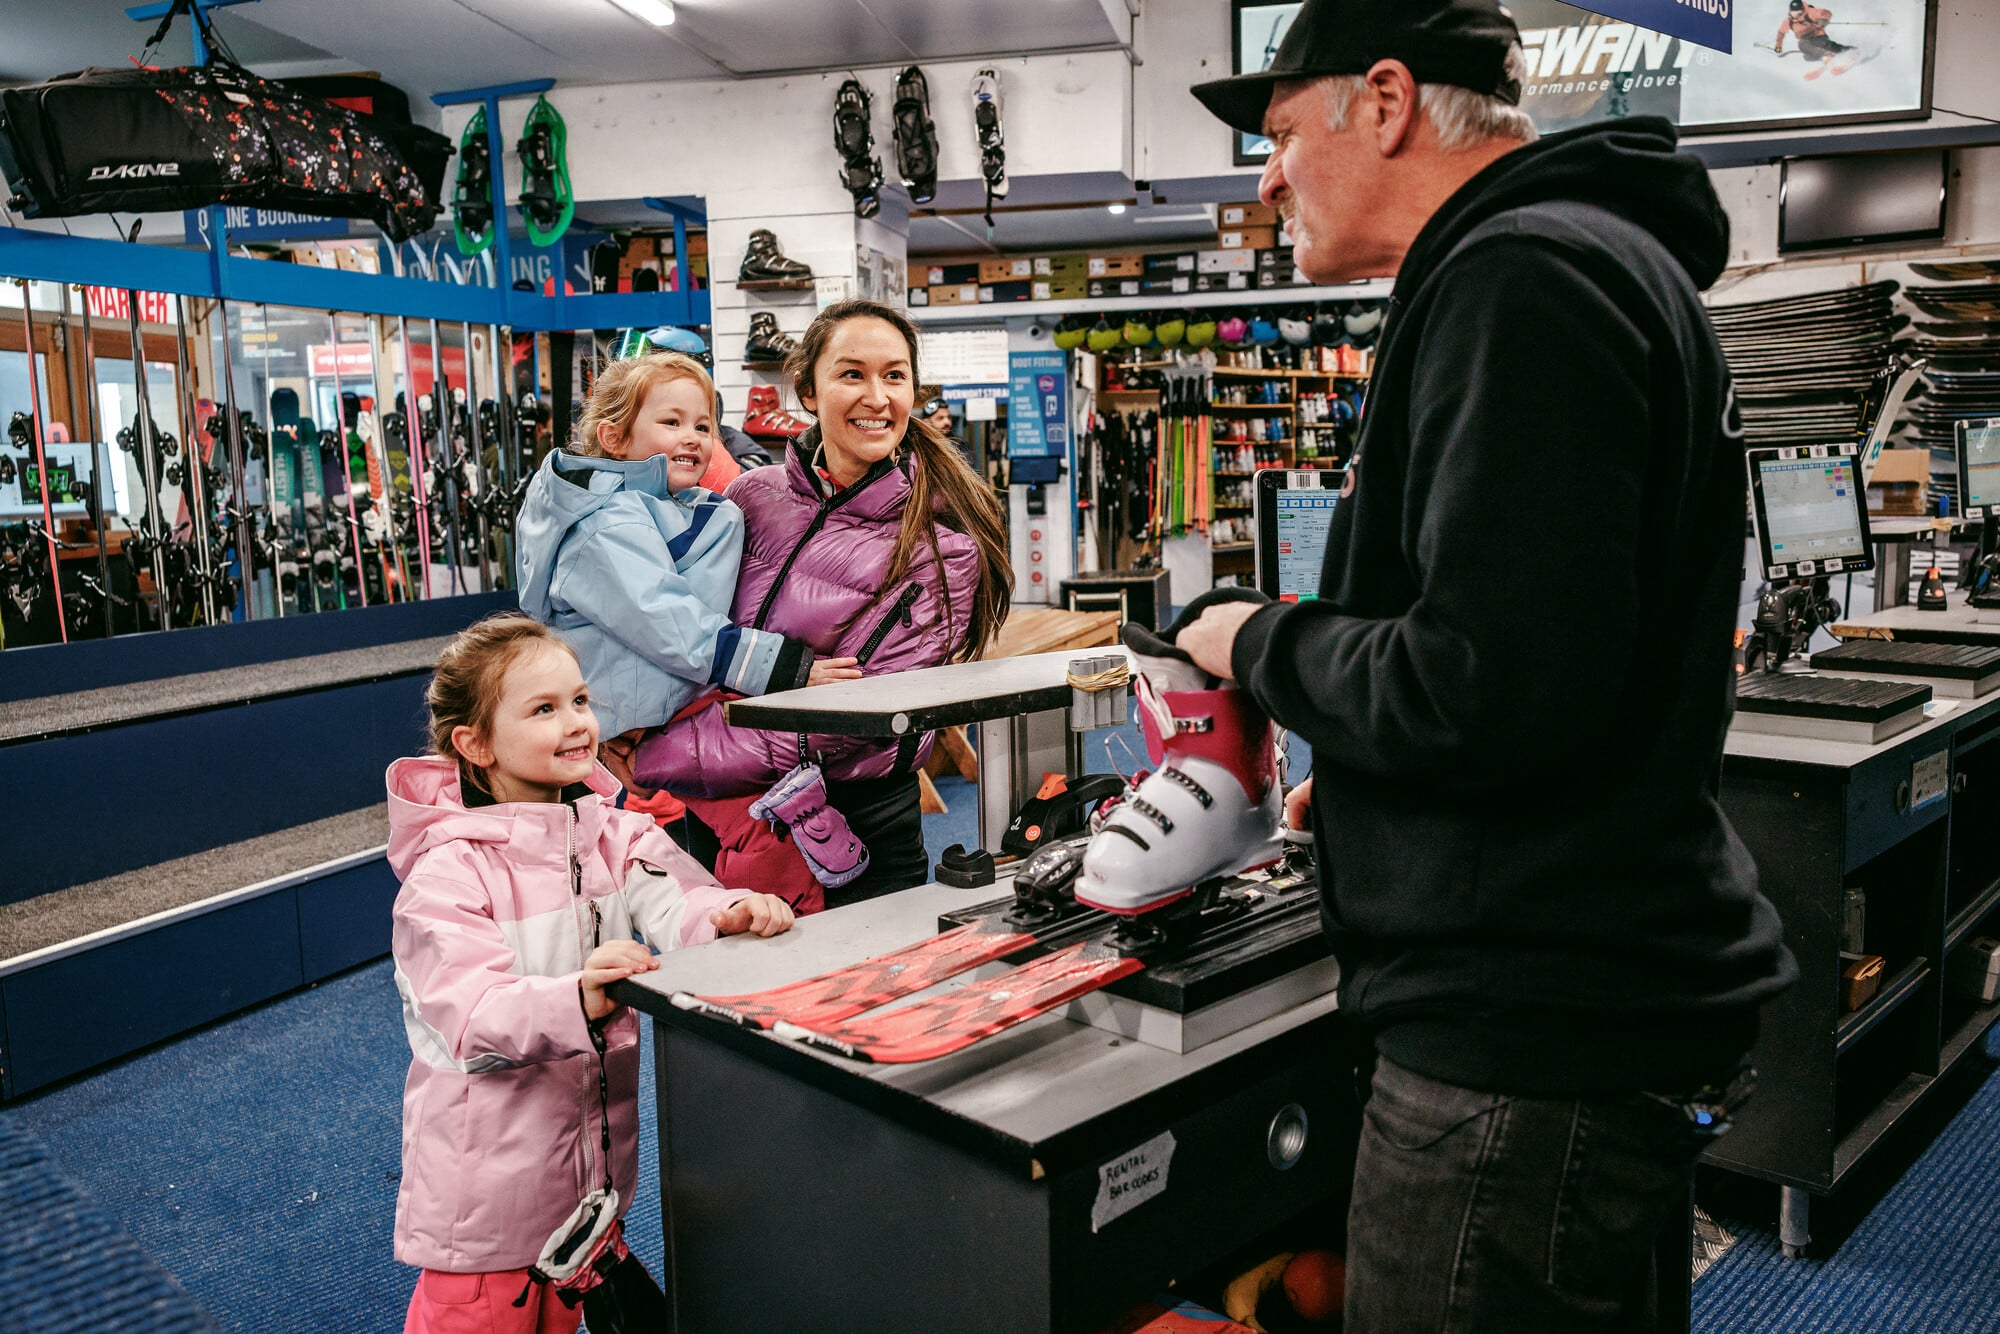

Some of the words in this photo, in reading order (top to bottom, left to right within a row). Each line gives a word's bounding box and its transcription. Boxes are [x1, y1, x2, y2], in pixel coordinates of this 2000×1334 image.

[1622, 72, 1690, 93] gloves
[86, 162, 181, 181] DAKINE
[1105, 1154, 1148, 1185] RENTAL
